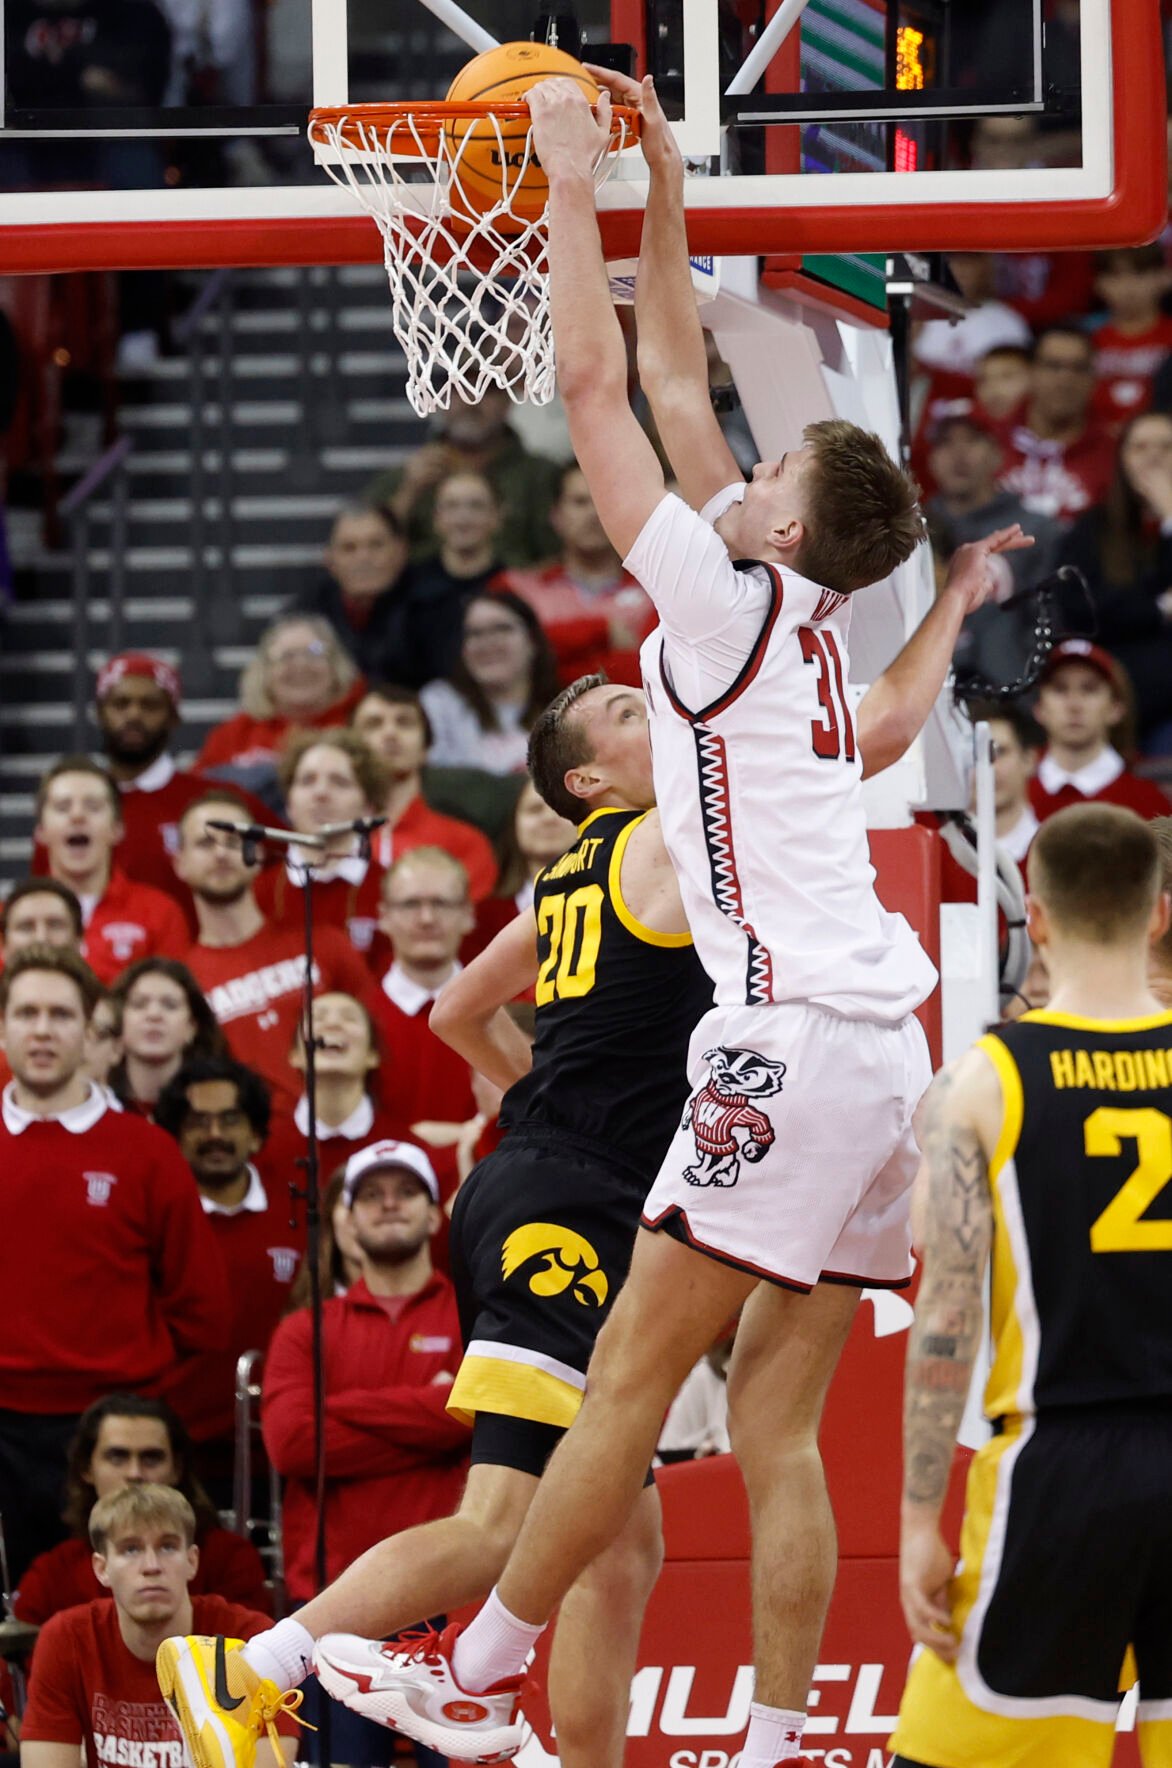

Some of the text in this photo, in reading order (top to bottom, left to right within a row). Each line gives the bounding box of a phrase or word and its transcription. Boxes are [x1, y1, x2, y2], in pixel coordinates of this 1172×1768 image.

[797, 626, 855, 763] 31
[535, 883, 605, 1007] 20
[1083, 1106, 1172, 1253] 2
